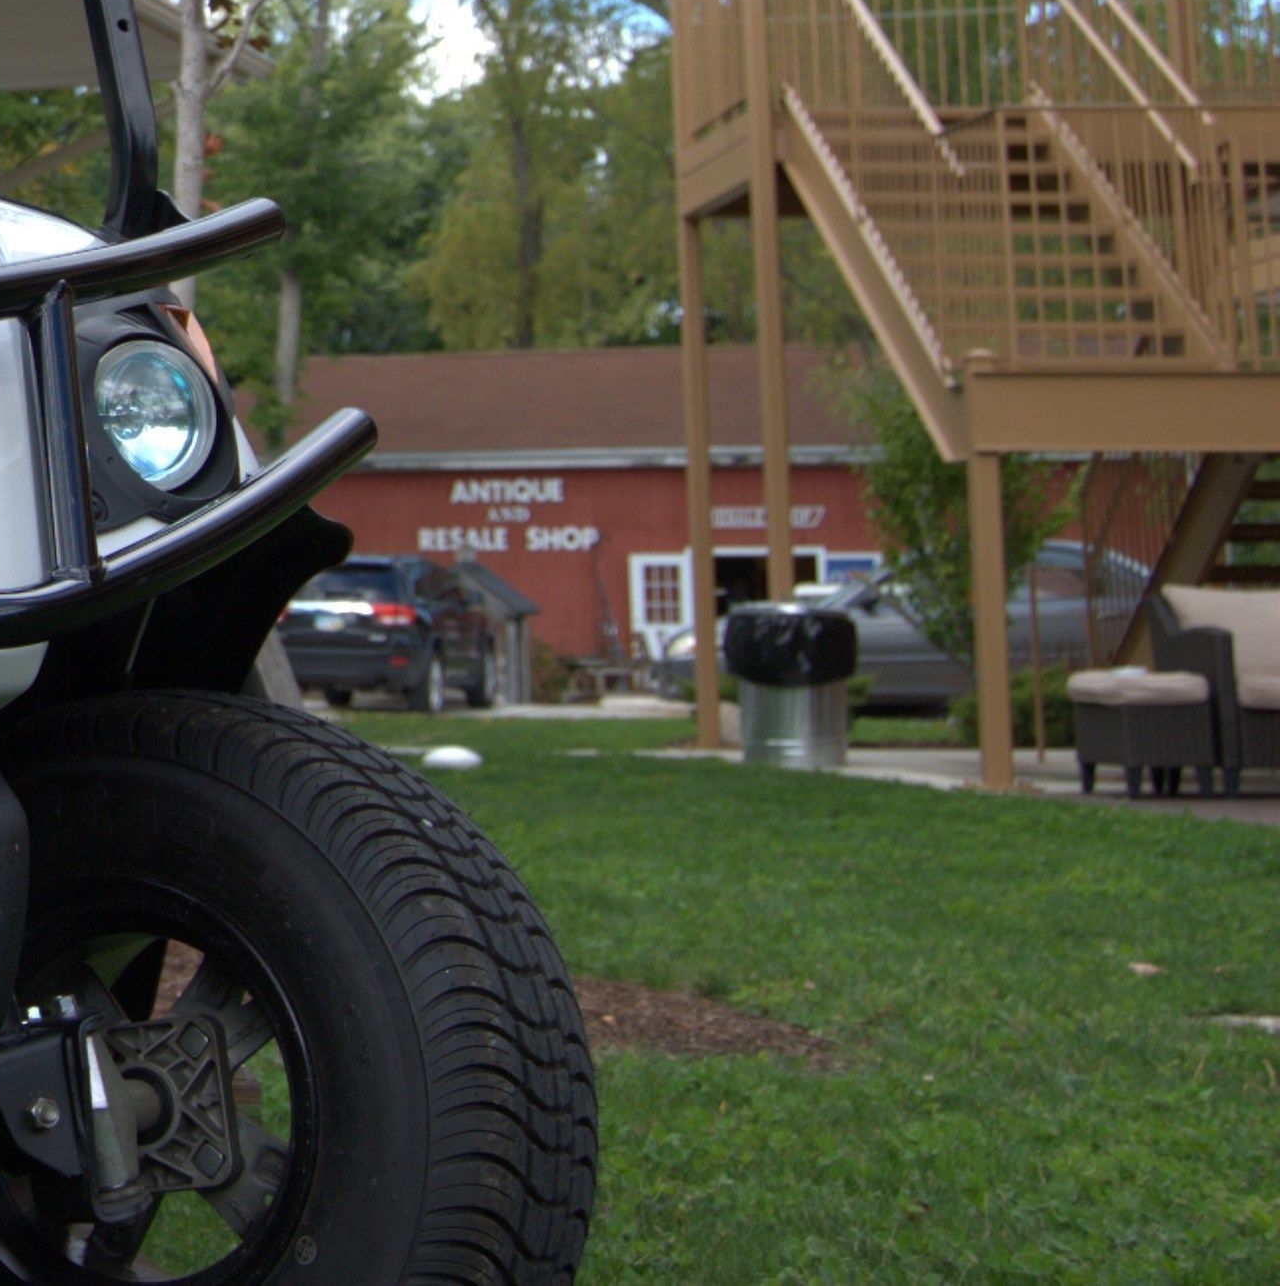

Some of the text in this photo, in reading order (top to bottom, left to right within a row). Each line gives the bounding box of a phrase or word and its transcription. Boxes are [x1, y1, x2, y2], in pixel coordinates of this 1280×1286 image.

[449, 477, 565, 504] ANTIQUE
[416, 525, 600, 552] RESALE SHOP
